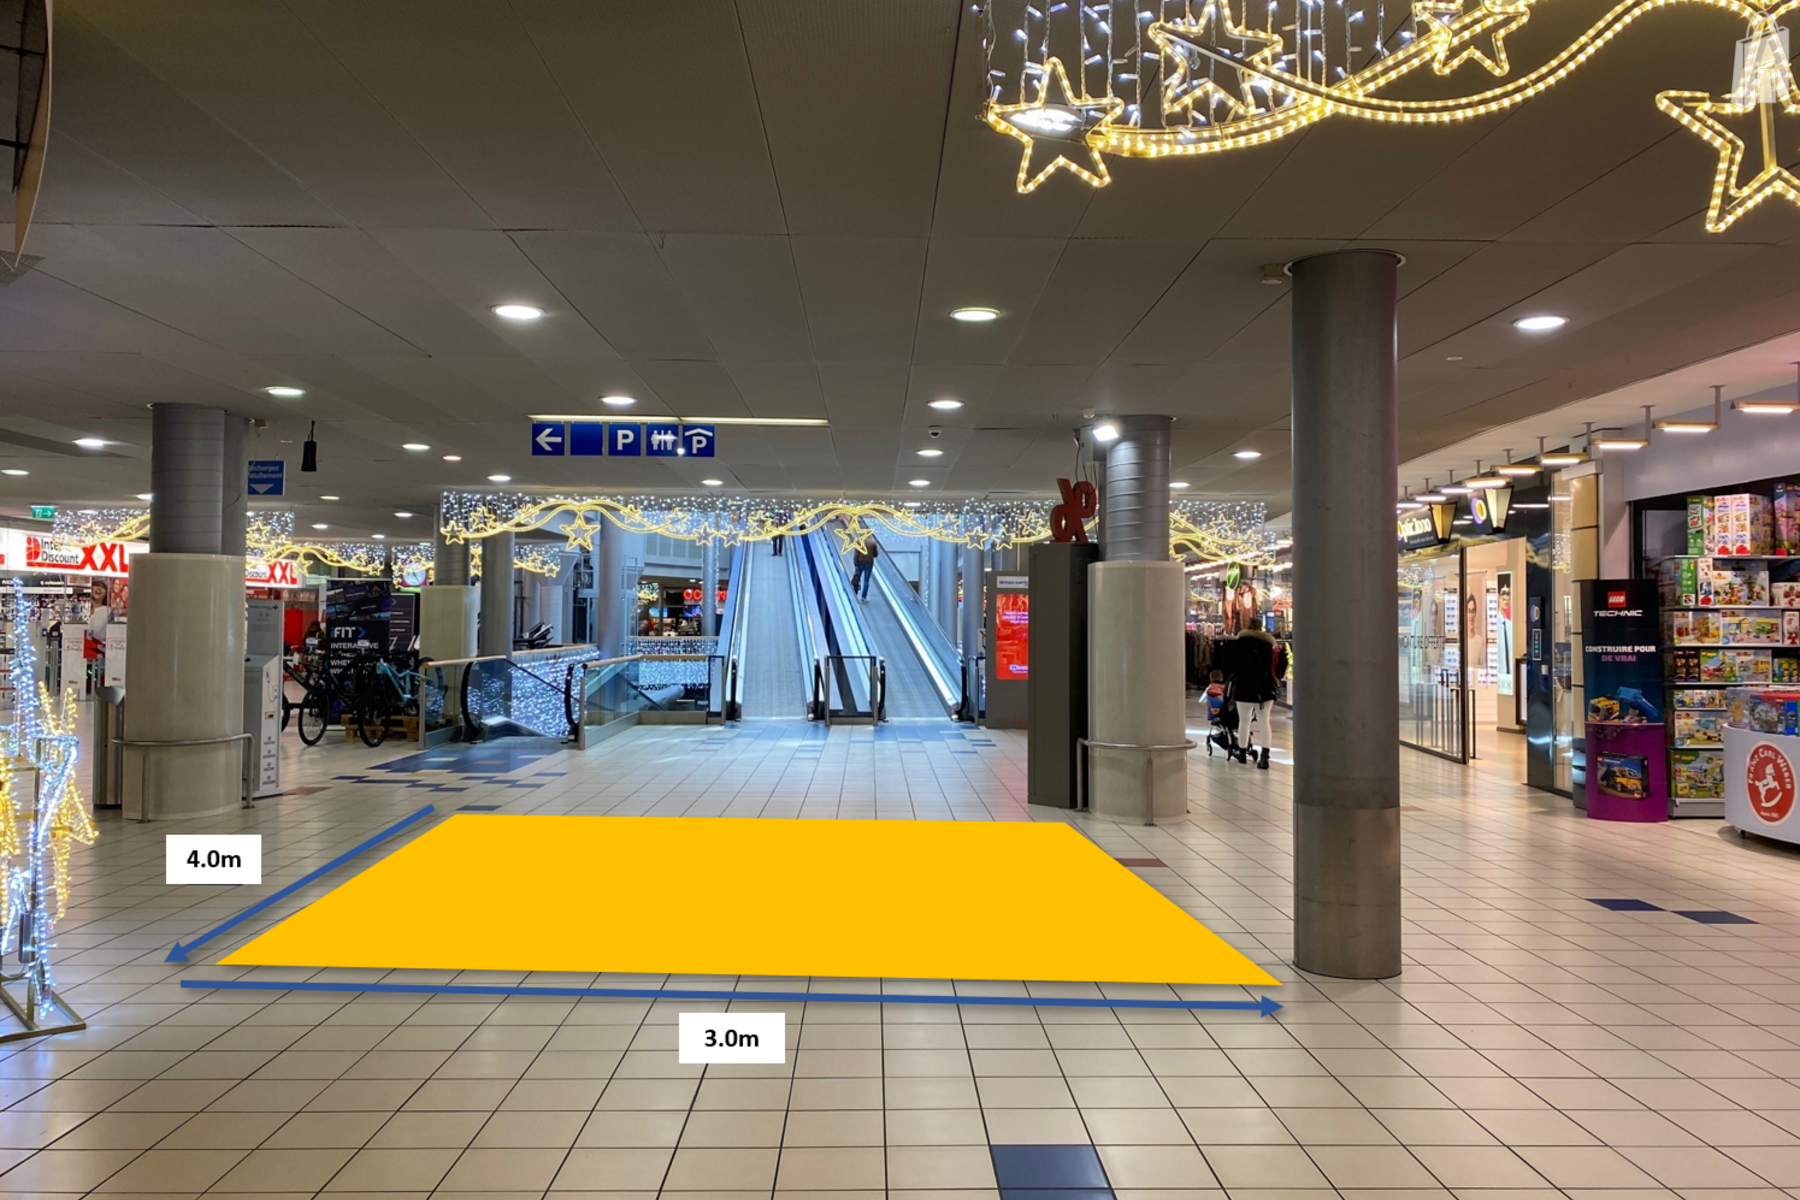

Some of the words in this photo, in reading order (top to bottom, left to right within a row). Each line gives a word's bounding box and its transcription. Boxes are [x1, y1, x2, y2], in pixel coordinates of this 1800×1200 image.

[617, 430, 634, 450] P
[692, 436, 707, 454] P
[41, 551, 79, 564] Discount
[80, 542, 129, 573] XXL
